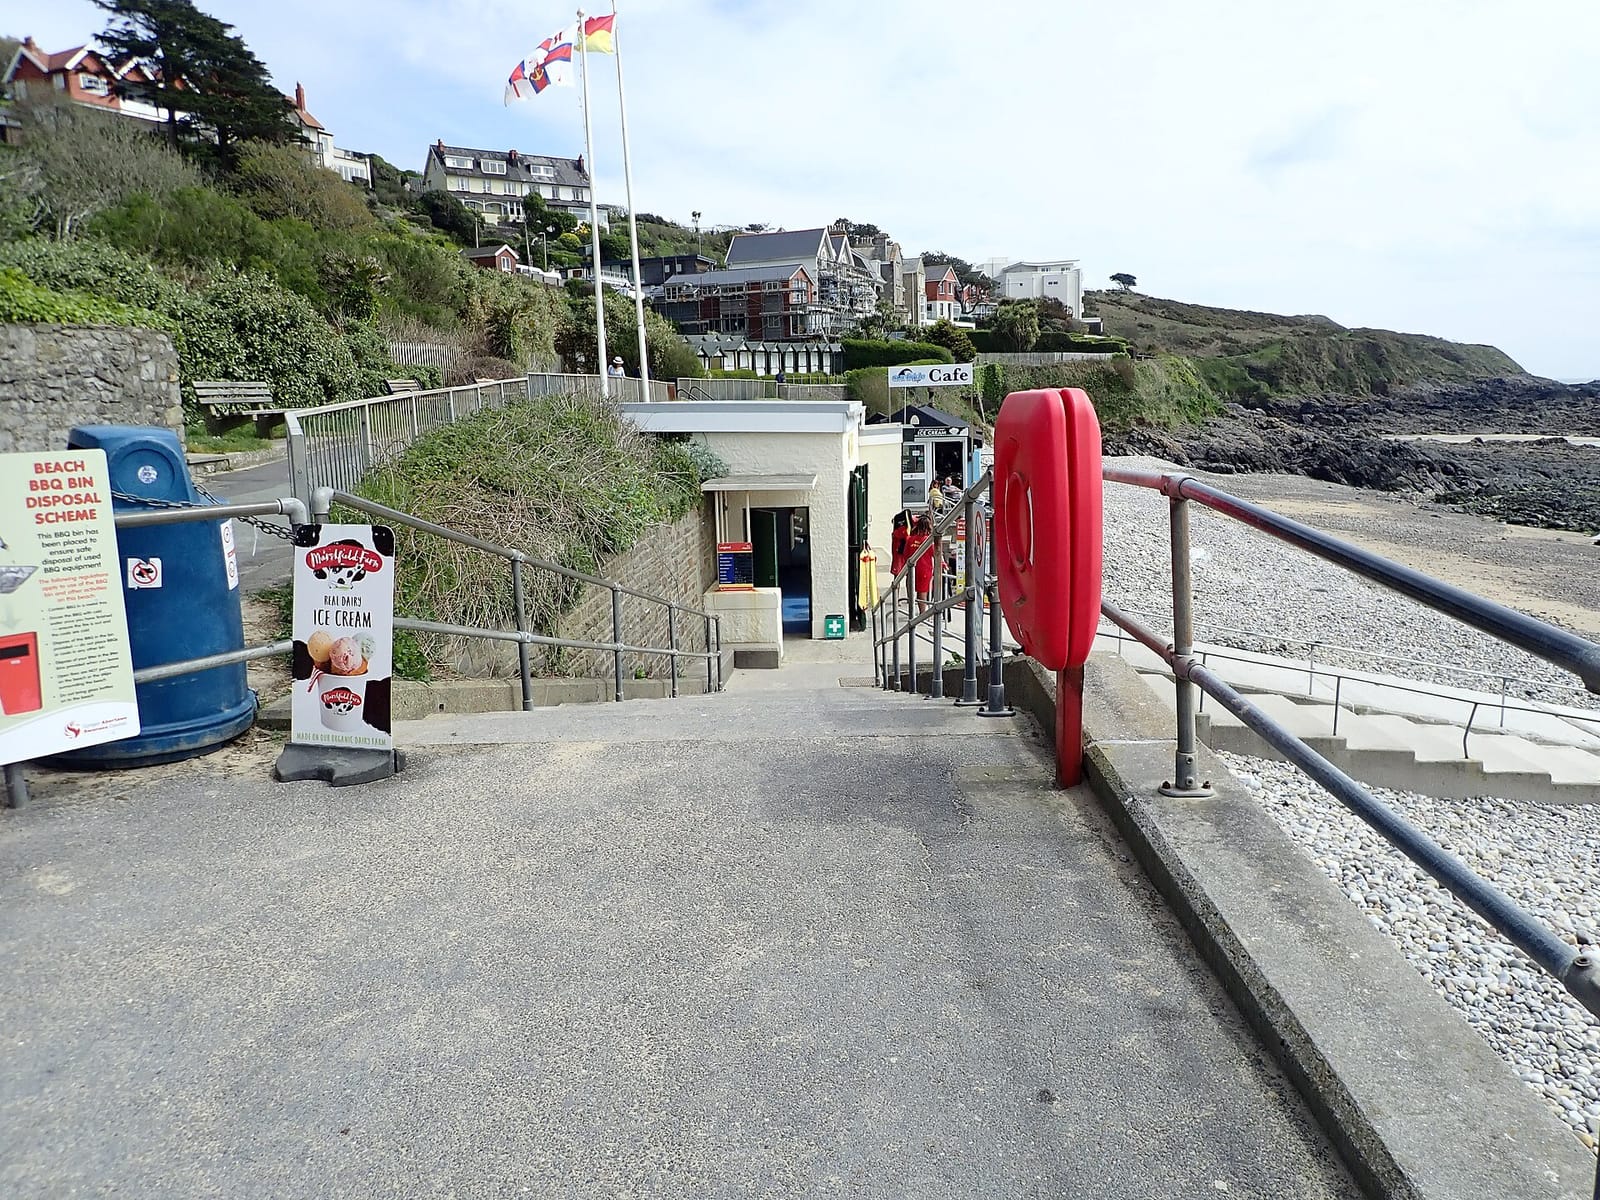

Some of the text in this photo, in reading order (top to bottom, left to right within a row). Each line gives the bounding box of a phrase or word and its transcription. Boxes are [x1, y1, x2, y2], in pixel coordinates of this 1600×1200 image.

[929, 368, 968, 382] Cafe
[34, 460, 85, 474] BEACH
[29, 476, 94, 491] BBQ BIN
[26, 492, 102, 508] DISPOSAL
[35, 509, 97, 524] SCHEME
[54, 530, 70, 538] BBQ
[63, 538, 88, 546] placed
[42, 556, 72, 565] disposal
[62, 562, 102, 572] equipment
[324, 595, 362, 607] REAL DAIRY
[313, 609, 372, 628] ICE CREAM
